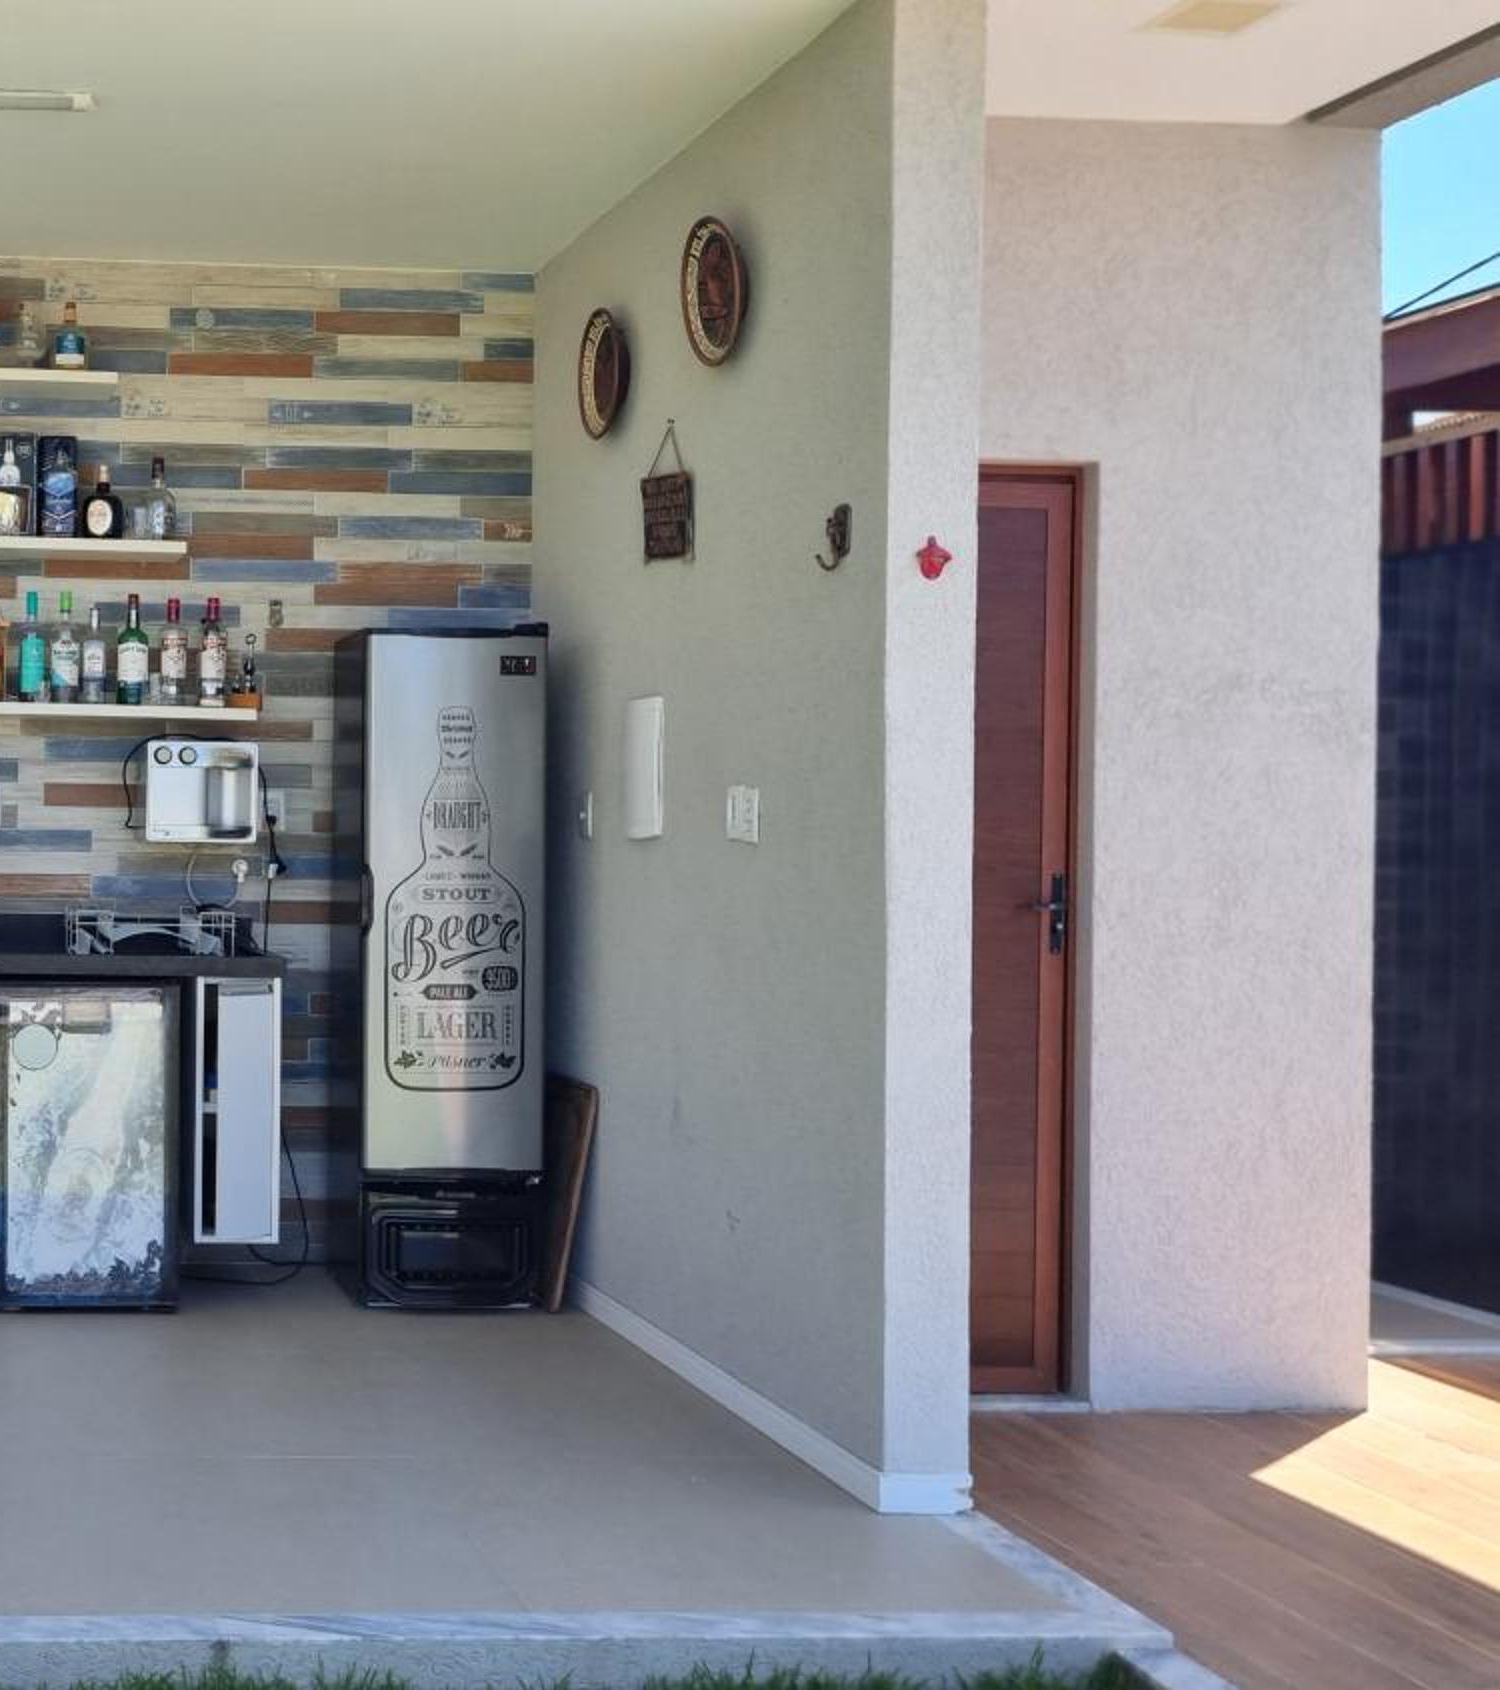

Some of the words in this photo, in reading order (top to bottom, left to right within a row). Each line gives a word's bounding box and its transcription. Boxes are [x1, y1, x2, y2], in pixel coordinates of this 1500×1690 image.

[421, 887, 491, 901] STOUT
[391, 913, 520, 982] Beer
[416, 1011, 498, 1039] LAGER
